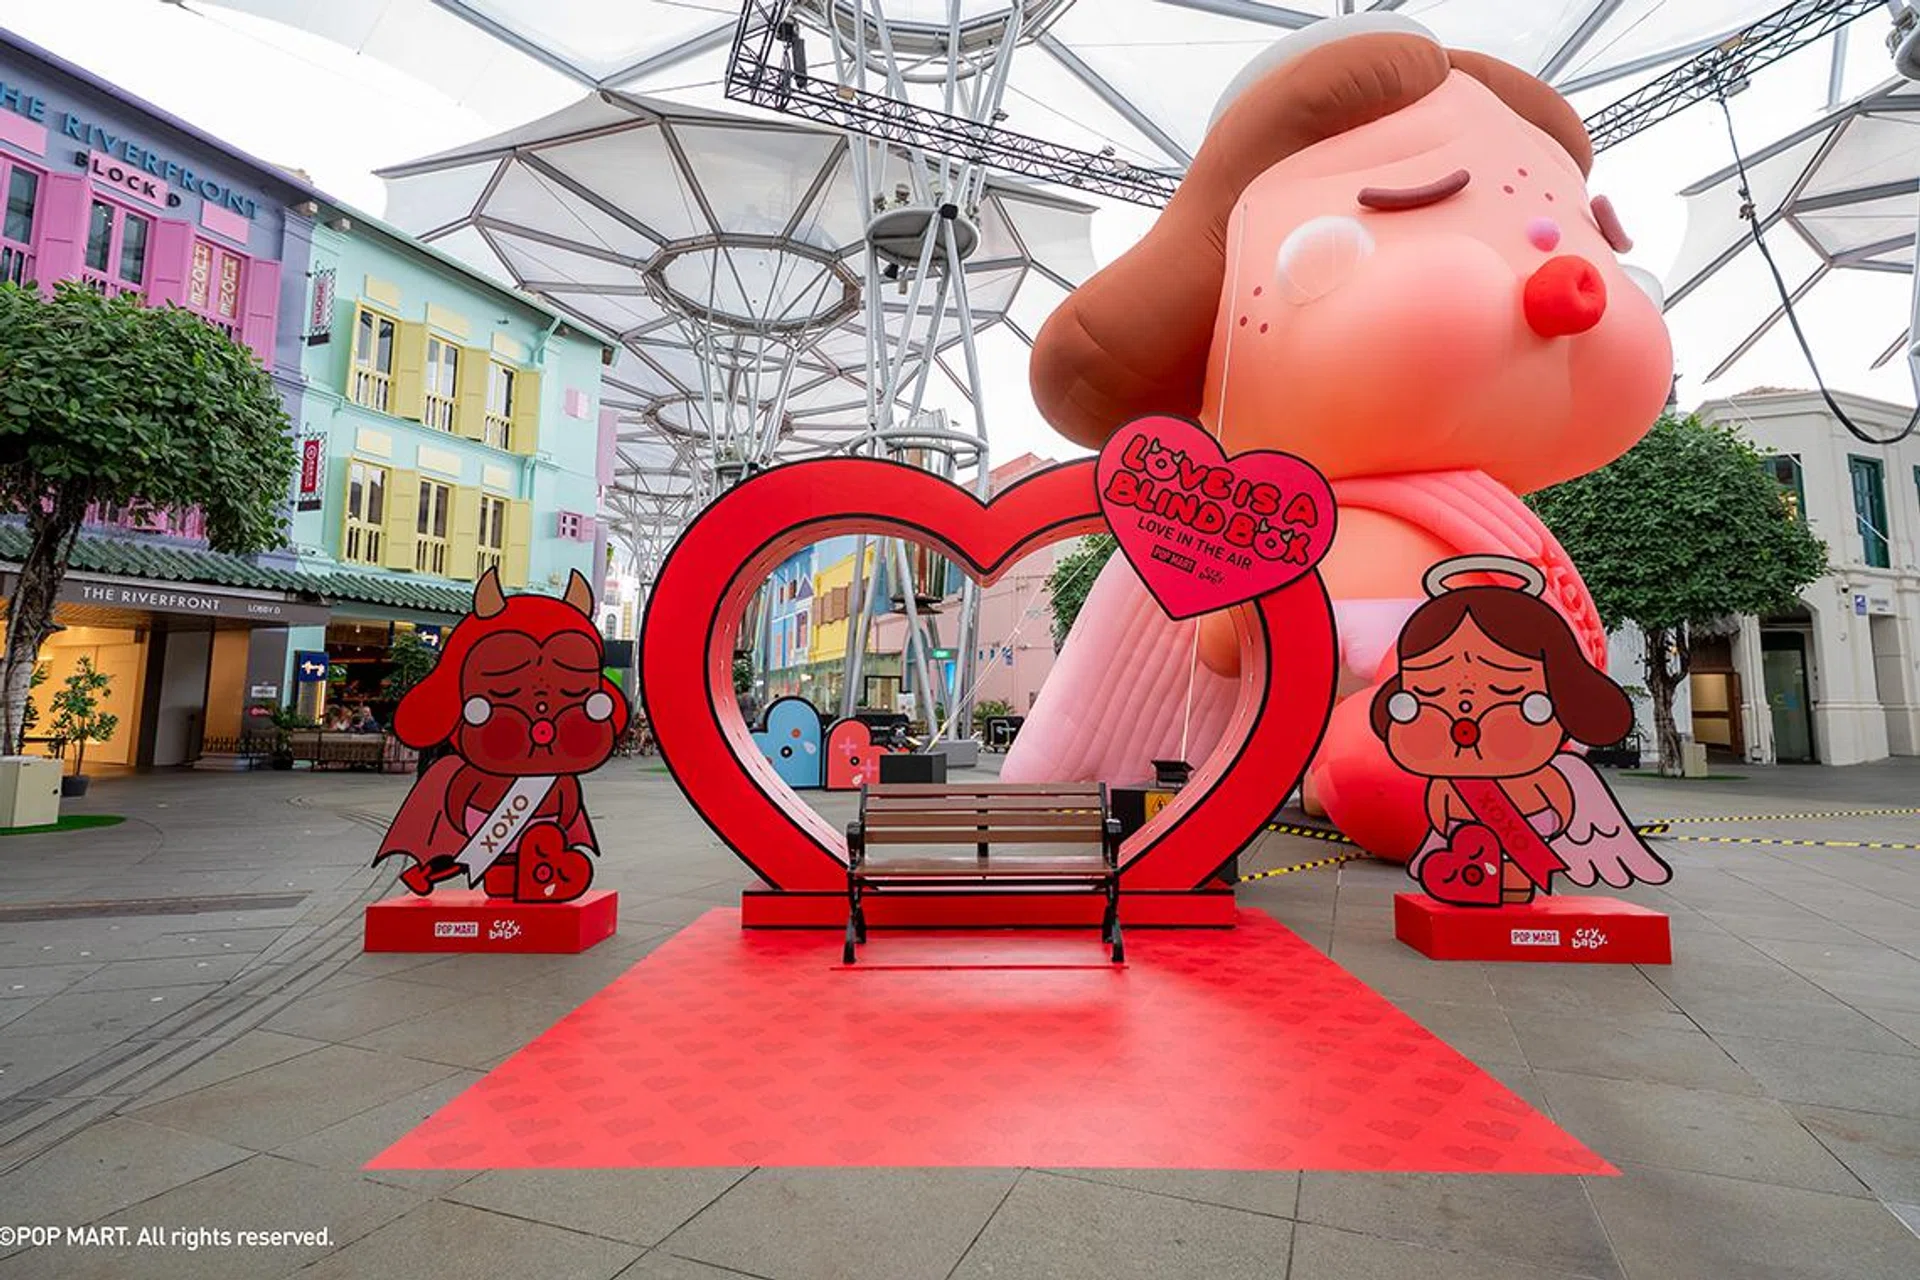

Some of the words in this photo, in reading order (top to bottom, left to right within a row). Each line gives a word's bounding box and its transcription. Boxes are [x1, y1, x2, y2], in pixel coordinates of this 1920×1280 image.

[63, 111, 260, 220] RIVERFRONT
[75, 151, 157, 199] BLOCK
[165, 192, 182, 209] D
[1122, 434, 1235, 499] LOVE
[1232, 479, 1281, 516] IS
[1282, 492, 1318, 528] A
[1104, 469, 1226, 534] BLIND
[1223, 511, 1311, 566] BOX
[1137, 516, 1175, 540] LOVE
[1176, 532, 1194, 547] IN
[1196, 538, 1225, 560] THE
[1226, 552, 1253, 571] AIR
[1152, 547, 1172, 562] POP
[1170, 553, 1195, 572] MART
[83, 586, 114, 600] THE
[122, 589, 220, 611] RIVERFRONT
[480, 795, 529, 853] XOXO
[1478, 790, 1529, 851] XOXO
[437, 924, 453, 934] POP
[454, 924, 476, 934] MART
[1512, 931, 1530, 942] POP
[1532, 931, 1558, 943] MART
[1576, 928, 1599, 939] cry
